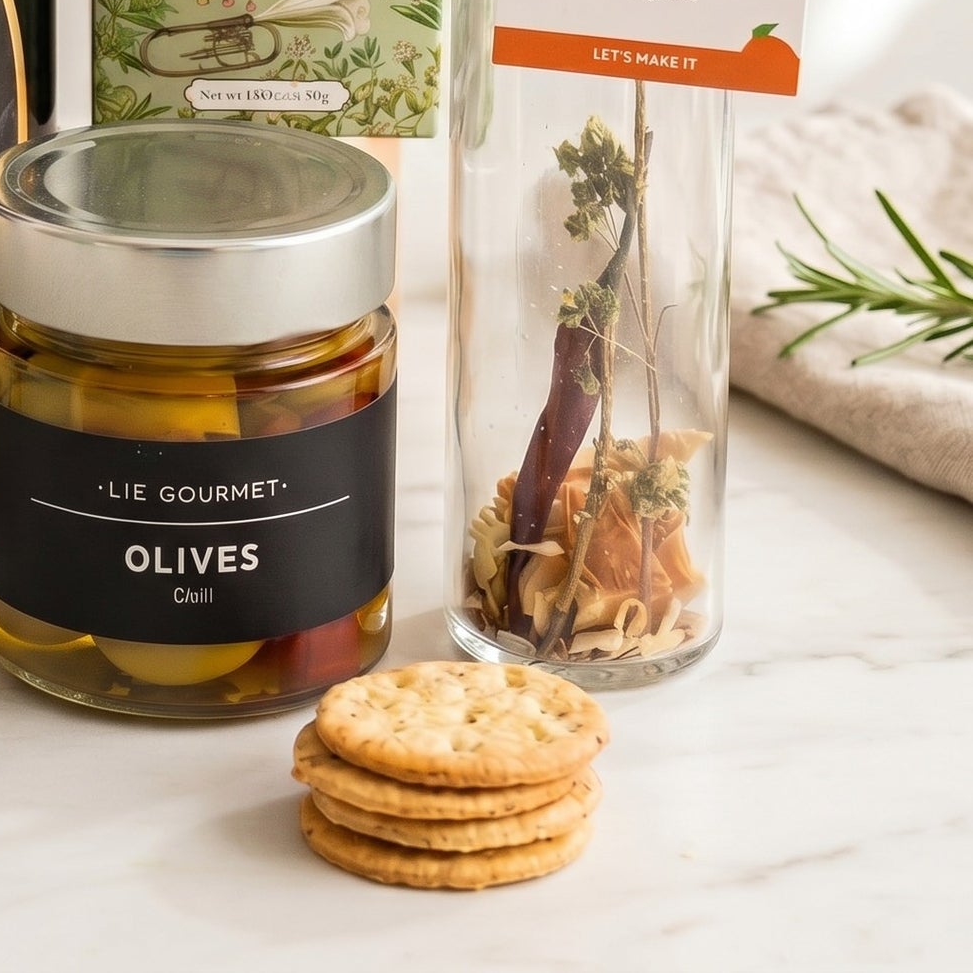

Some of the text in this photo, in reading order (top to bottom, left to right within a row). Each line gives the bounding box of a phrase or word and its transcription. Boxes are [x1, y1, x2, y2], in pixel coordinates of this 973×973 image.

[593, 47, 698, 70] LET'S MAKE IT
[109, 478, 280, 504] LIE GOURMET
[125, 543, 259, 575] OLIVES
